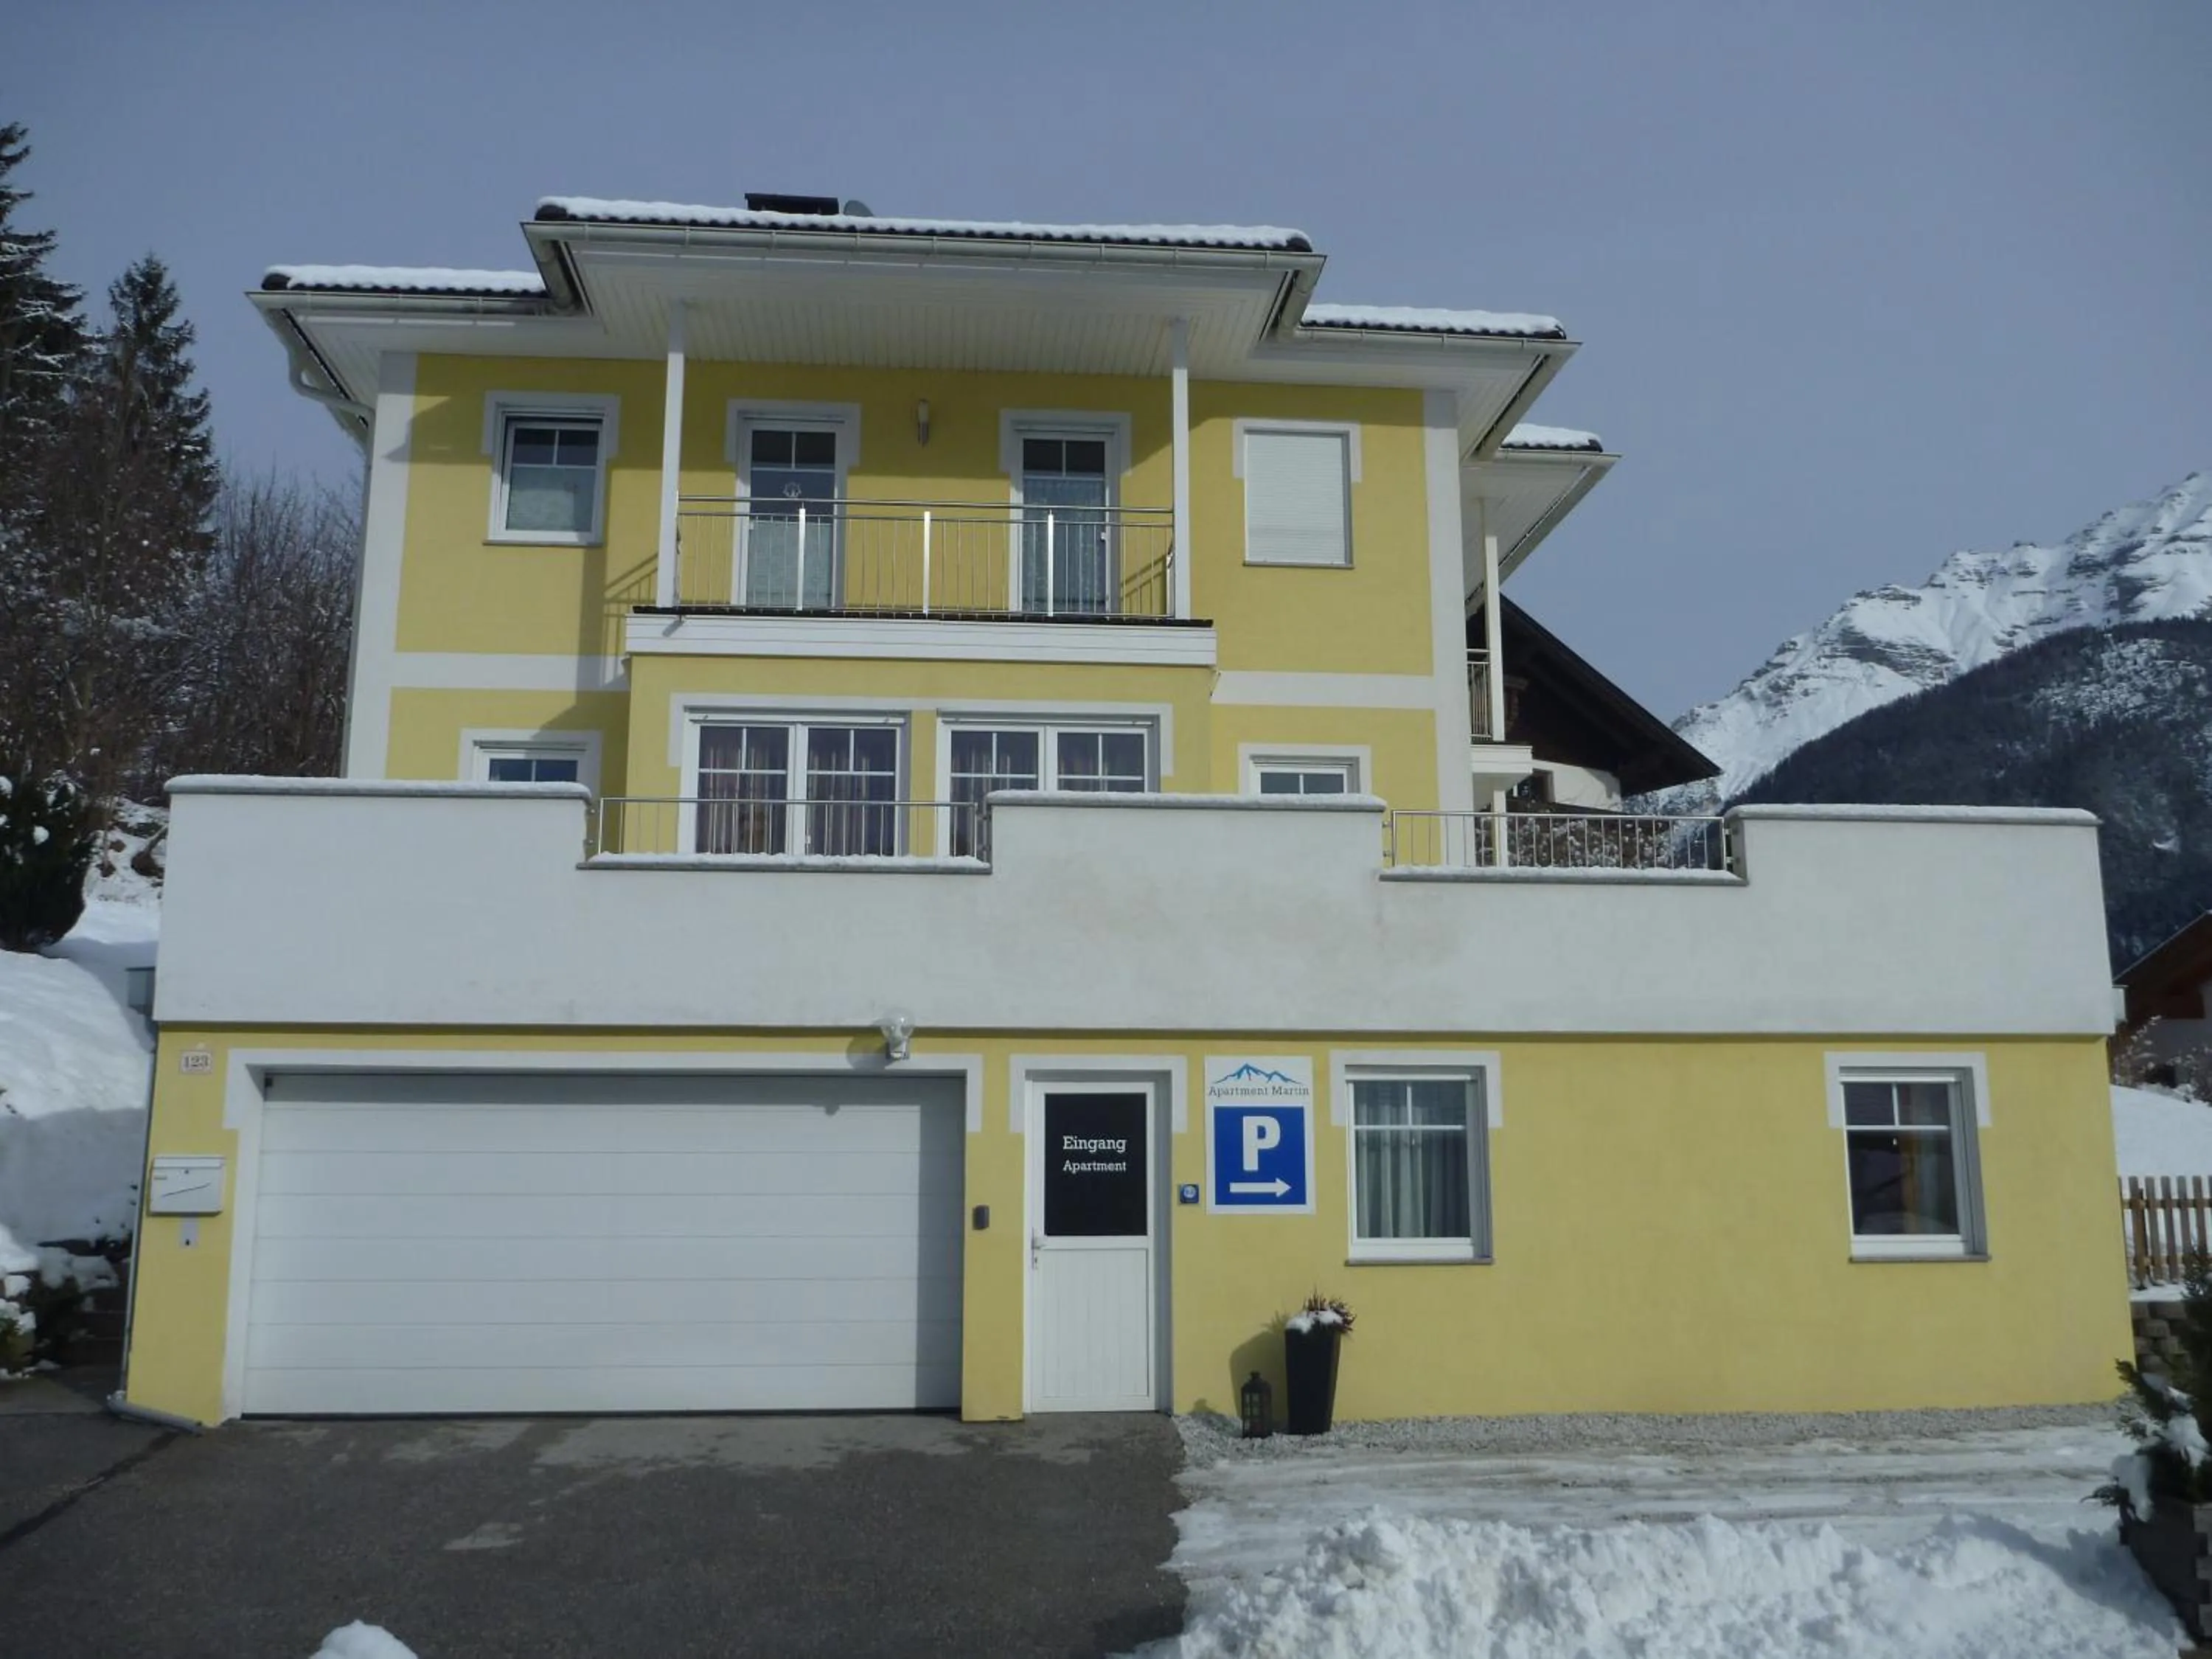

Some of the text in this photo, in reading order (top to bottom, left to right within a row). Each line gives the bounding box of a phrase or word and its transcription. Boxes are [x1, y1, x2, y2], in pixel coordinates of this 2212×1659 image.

[1209, 1085, 1309, 1097] Apartment Martin
[1062, 1135, 1127, 1154] Eingang
[1242, 1116, 1281, 1171] P
[1062, 1159, 1127, 1174] Apartment
